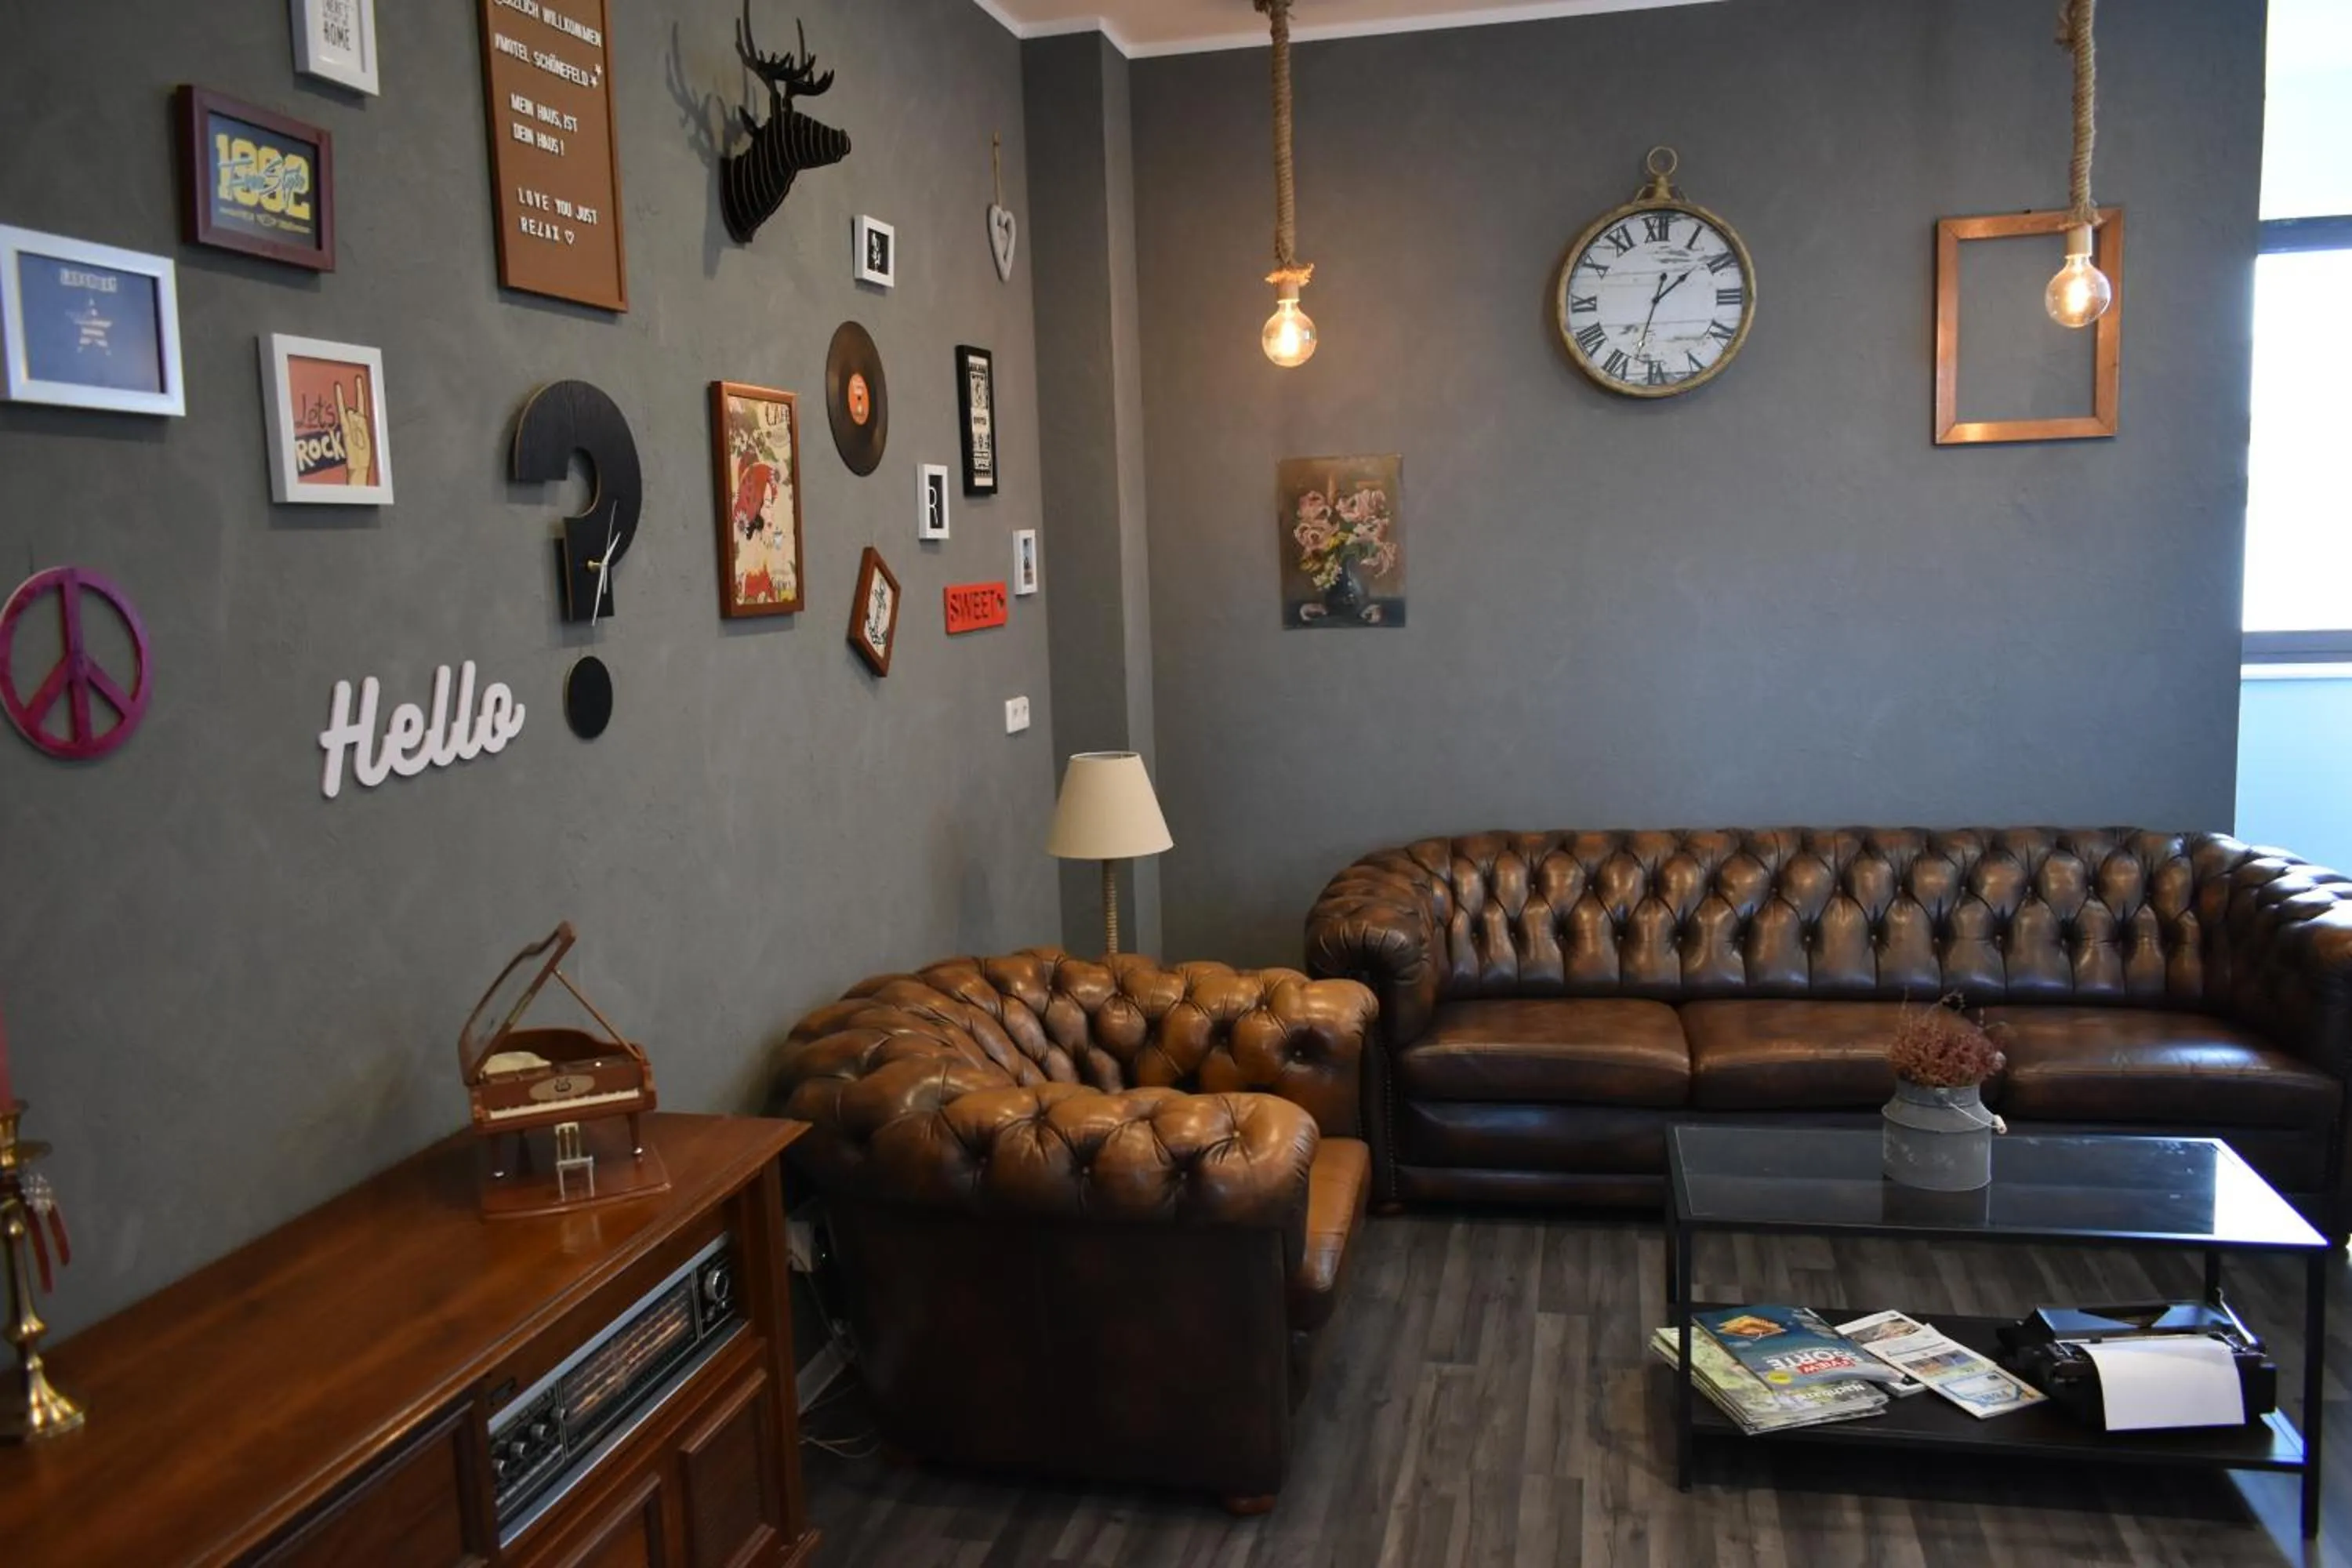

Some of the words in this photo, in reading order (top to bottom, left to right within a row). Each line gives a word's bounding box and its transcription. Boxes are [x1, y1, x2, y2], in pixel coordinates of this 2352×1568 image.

[494, 0, 539, 18] RZLICH
[542, 7, 602, 47] WILLKOMMEN
[510, 93, 534, 117] MEIN
[514, 122, 534, 144] DEIN
[518, 187, 550, 210] LOVE
[554, 198, 572, 217] YOU
[576, 205, 597, 225] JUST
[521, 216, 560, 240] RELAX
[1606, 224, 1636, 257] XI
[1643, 216, 1670, 243] XII
[1686, 224, 1704, 250] I
[1582, 254, 1610, 279] X
[1707, 252, 1736, 274] II
[1571, 294, 1597, 313] IX
[1716, 289, 1743, 305] III
[1577, 322, 1608, 357] VIII
[1602, 348, 1631, 380] VII
[294, 394, 336, 429] Let's
[296, 430, 346, 471] ROCK
[950, 590, 995, 622] SWEET
[318, 660, 525, 798] Hello
